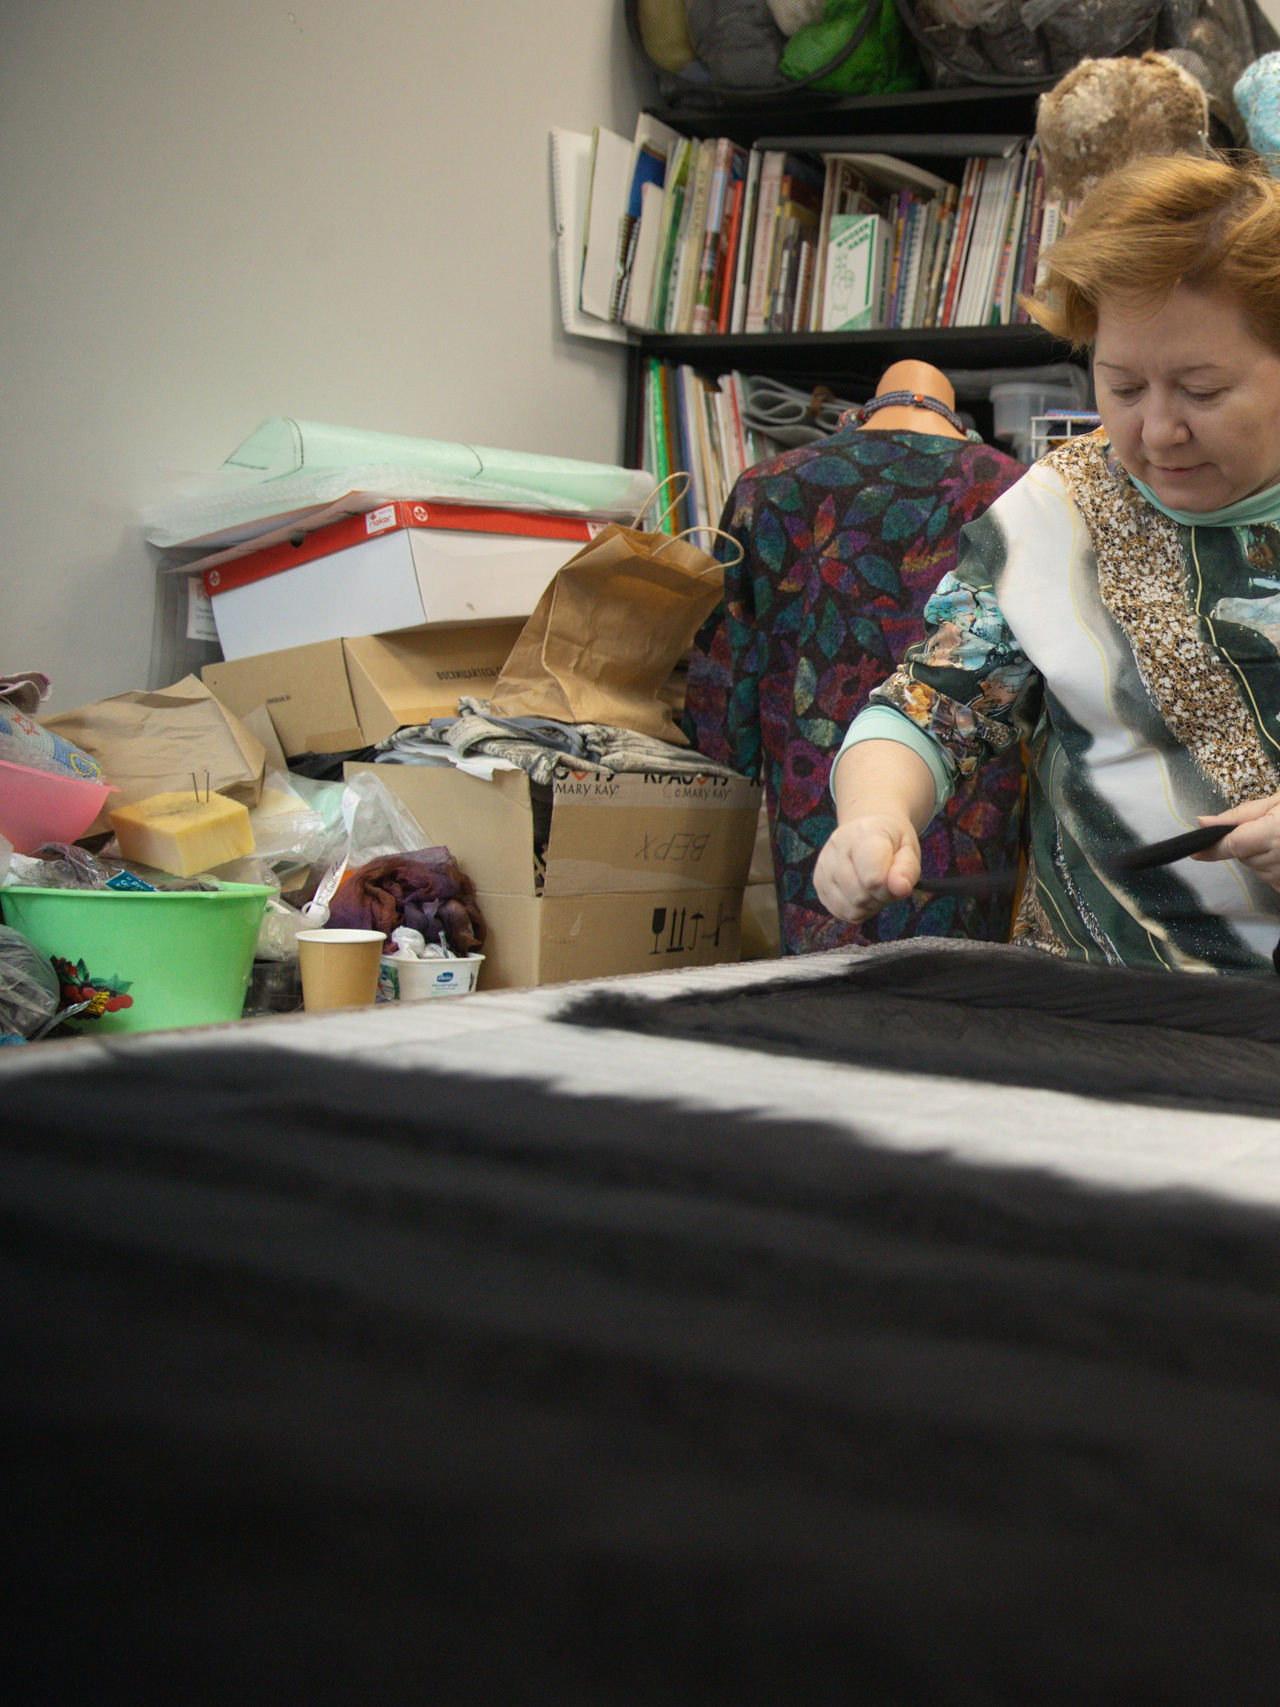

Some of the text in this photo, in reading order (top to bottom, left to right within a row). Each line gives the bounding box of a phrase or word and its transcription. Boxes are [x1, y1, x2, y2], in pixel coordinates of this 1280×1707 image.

[555, 783, 592, 797] MARY
[682, 788, 711, 799] MARY
[634, 832, 711, 861] ВЕРХ
